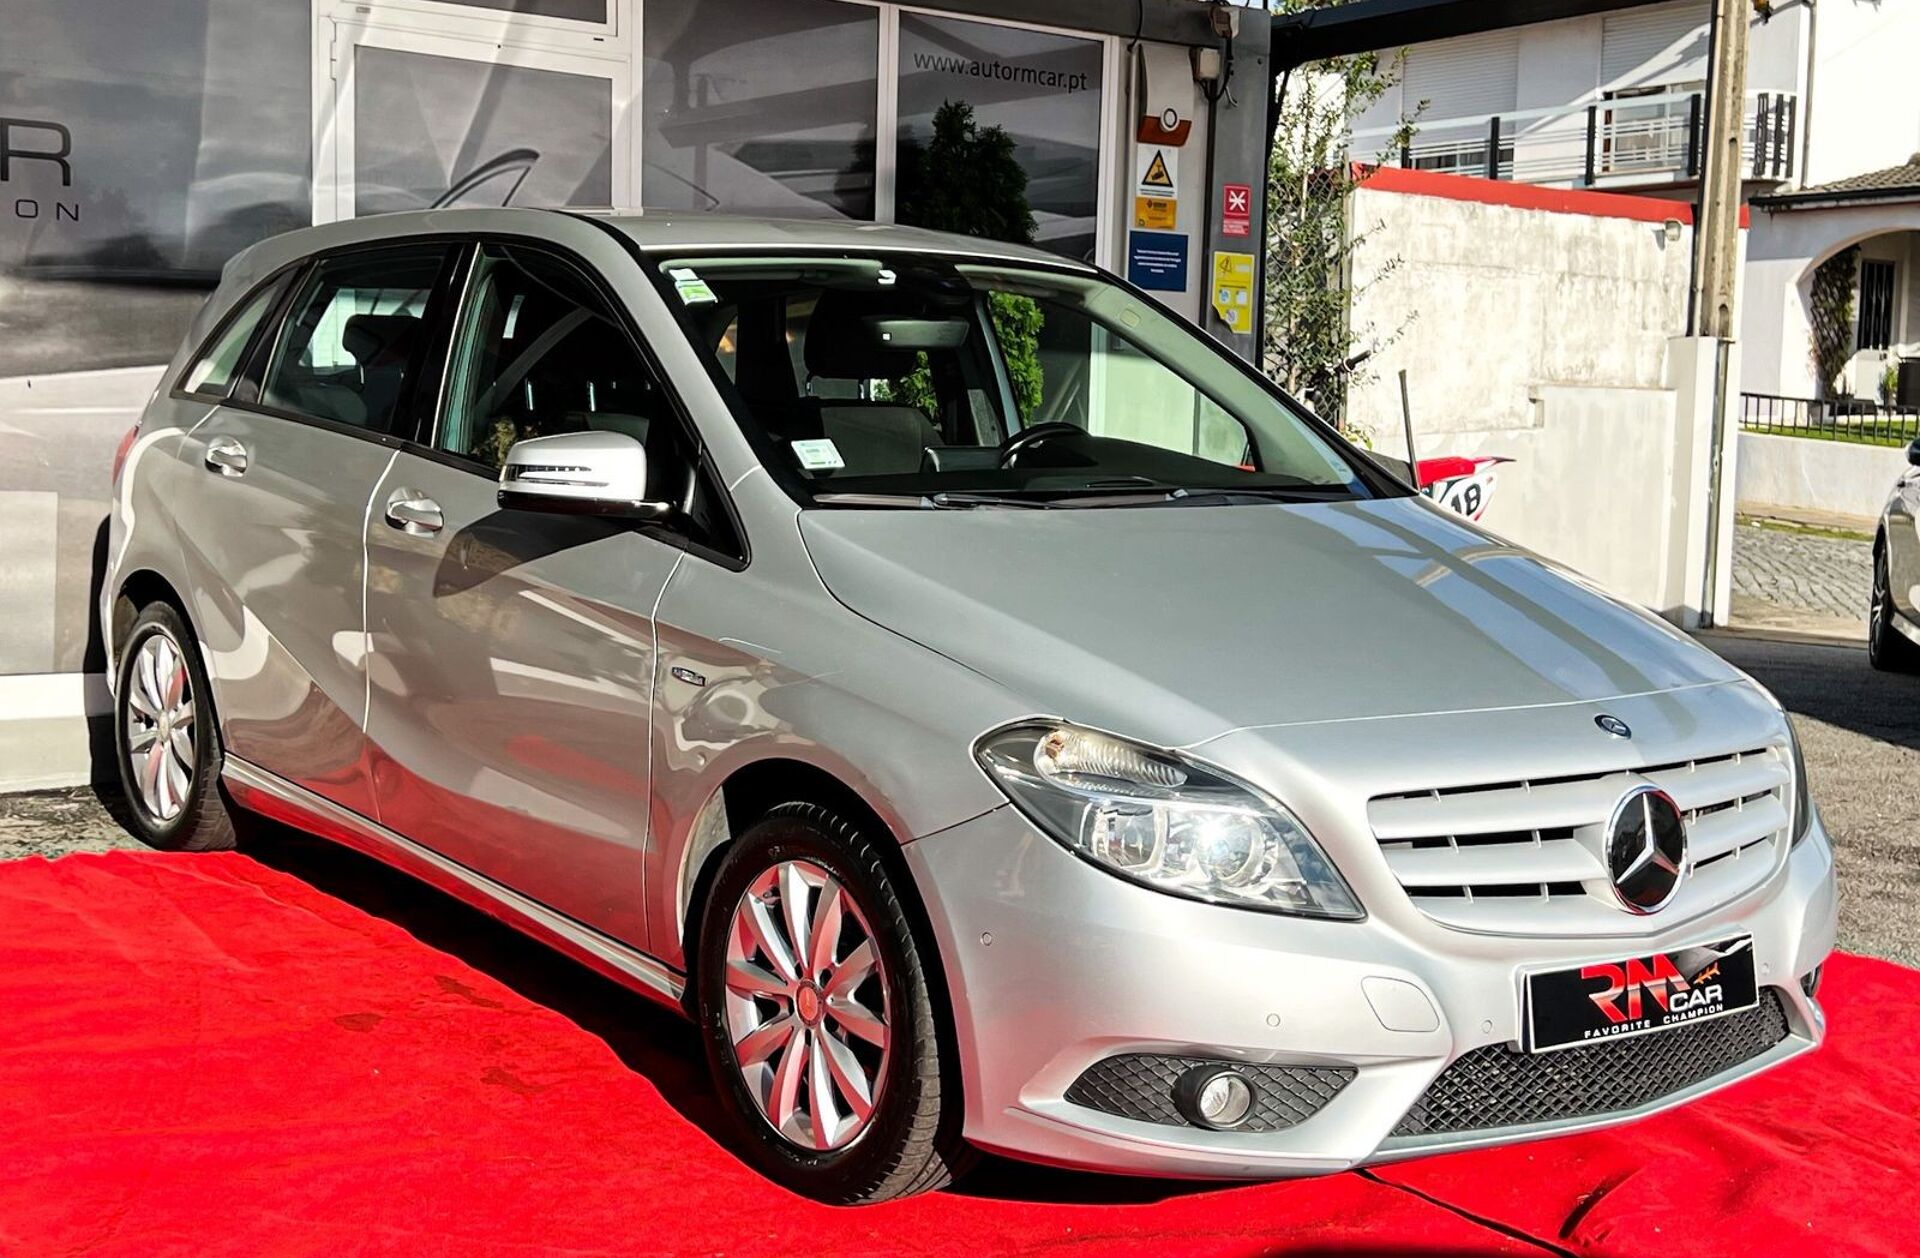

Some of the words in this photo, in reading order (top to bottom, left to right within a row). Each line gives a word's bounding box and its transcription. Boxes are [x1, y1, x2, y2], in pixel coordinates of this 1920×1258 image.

[914, 53, 1087, 93] www.autormcar.pt
[1450, 483, 1481, 516] 18
[1669, 984, 1723, 1013] CAR
[1584, 1019, 1651, 1039] FAVORITE
[1662, 1003, 1723, 1025] CHAMPION
